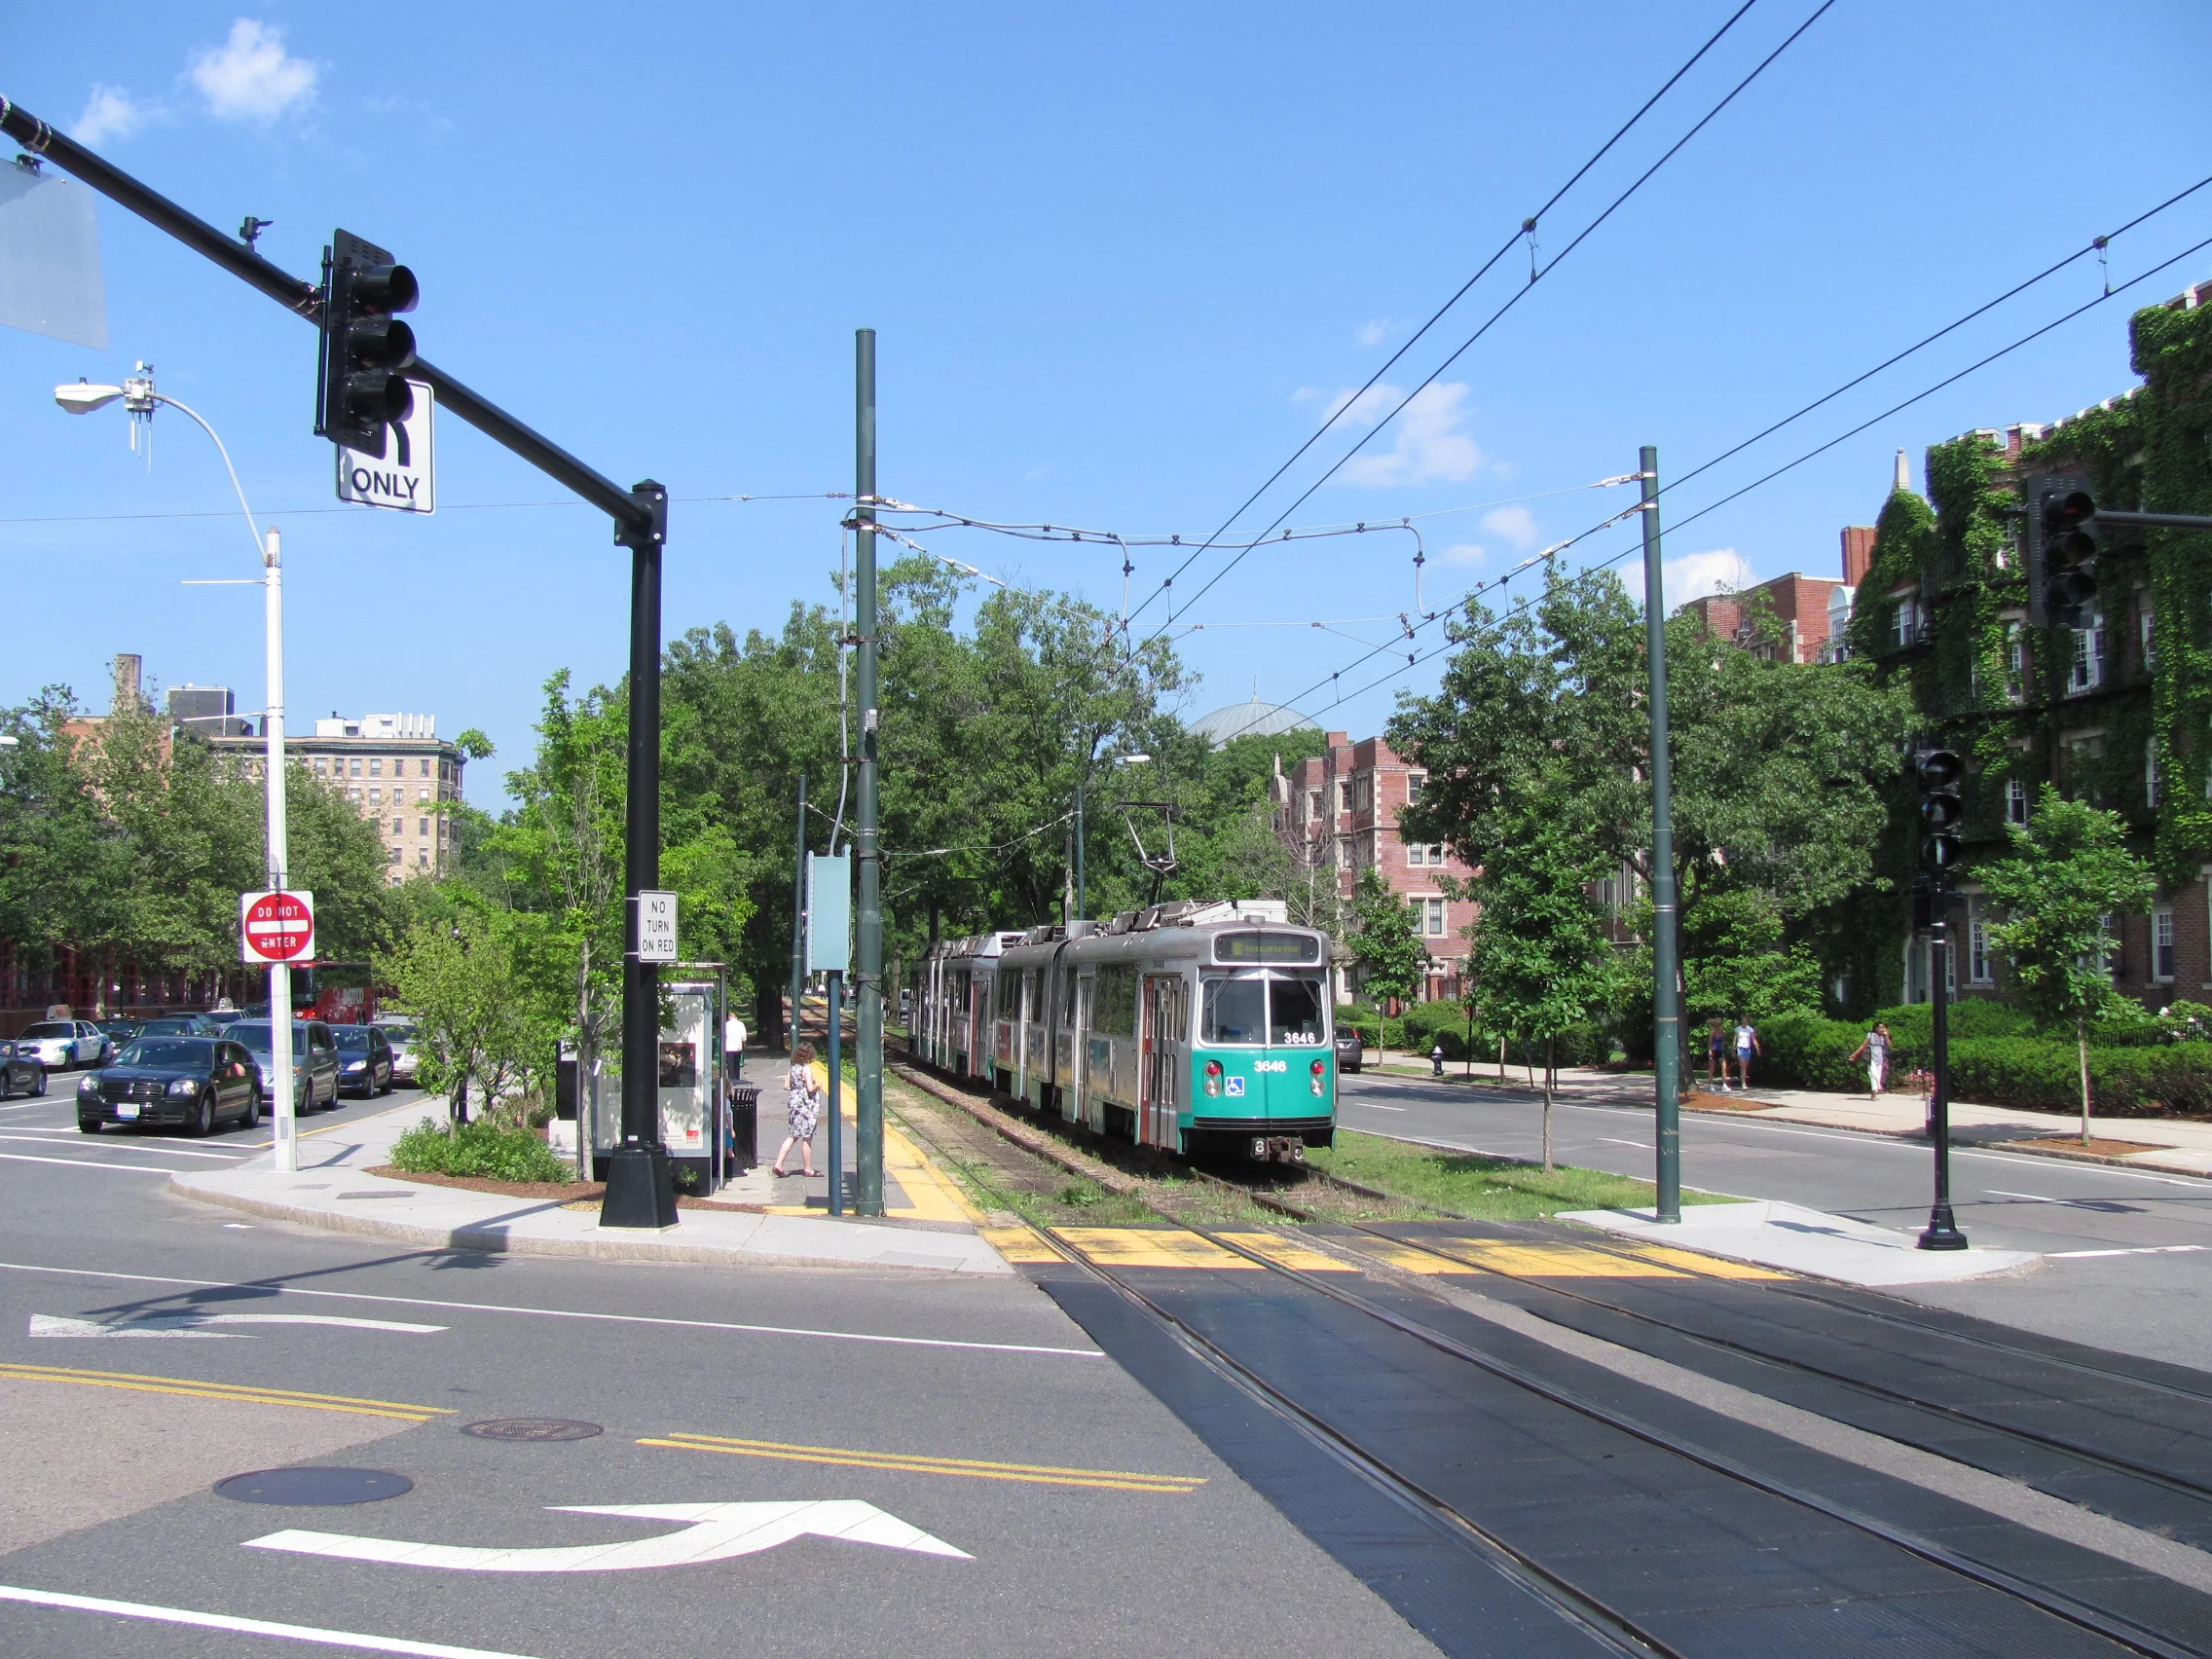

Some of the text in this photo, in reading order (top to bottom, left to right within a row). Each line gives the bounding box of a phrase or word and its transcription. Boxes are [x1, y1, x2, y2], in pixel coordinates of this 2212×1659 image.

[352, 468, 419, 499] ONLY
[258, 905, 299, 918] DO NOT
[651, 901, 666, 913] NO
[647, 920, 669, 933] TURN
[643, 940, 674, 952] ON RED
[1284, 1032, 1315, 1044] 3646
[1254, 1060, 1287, 1072] 3646
